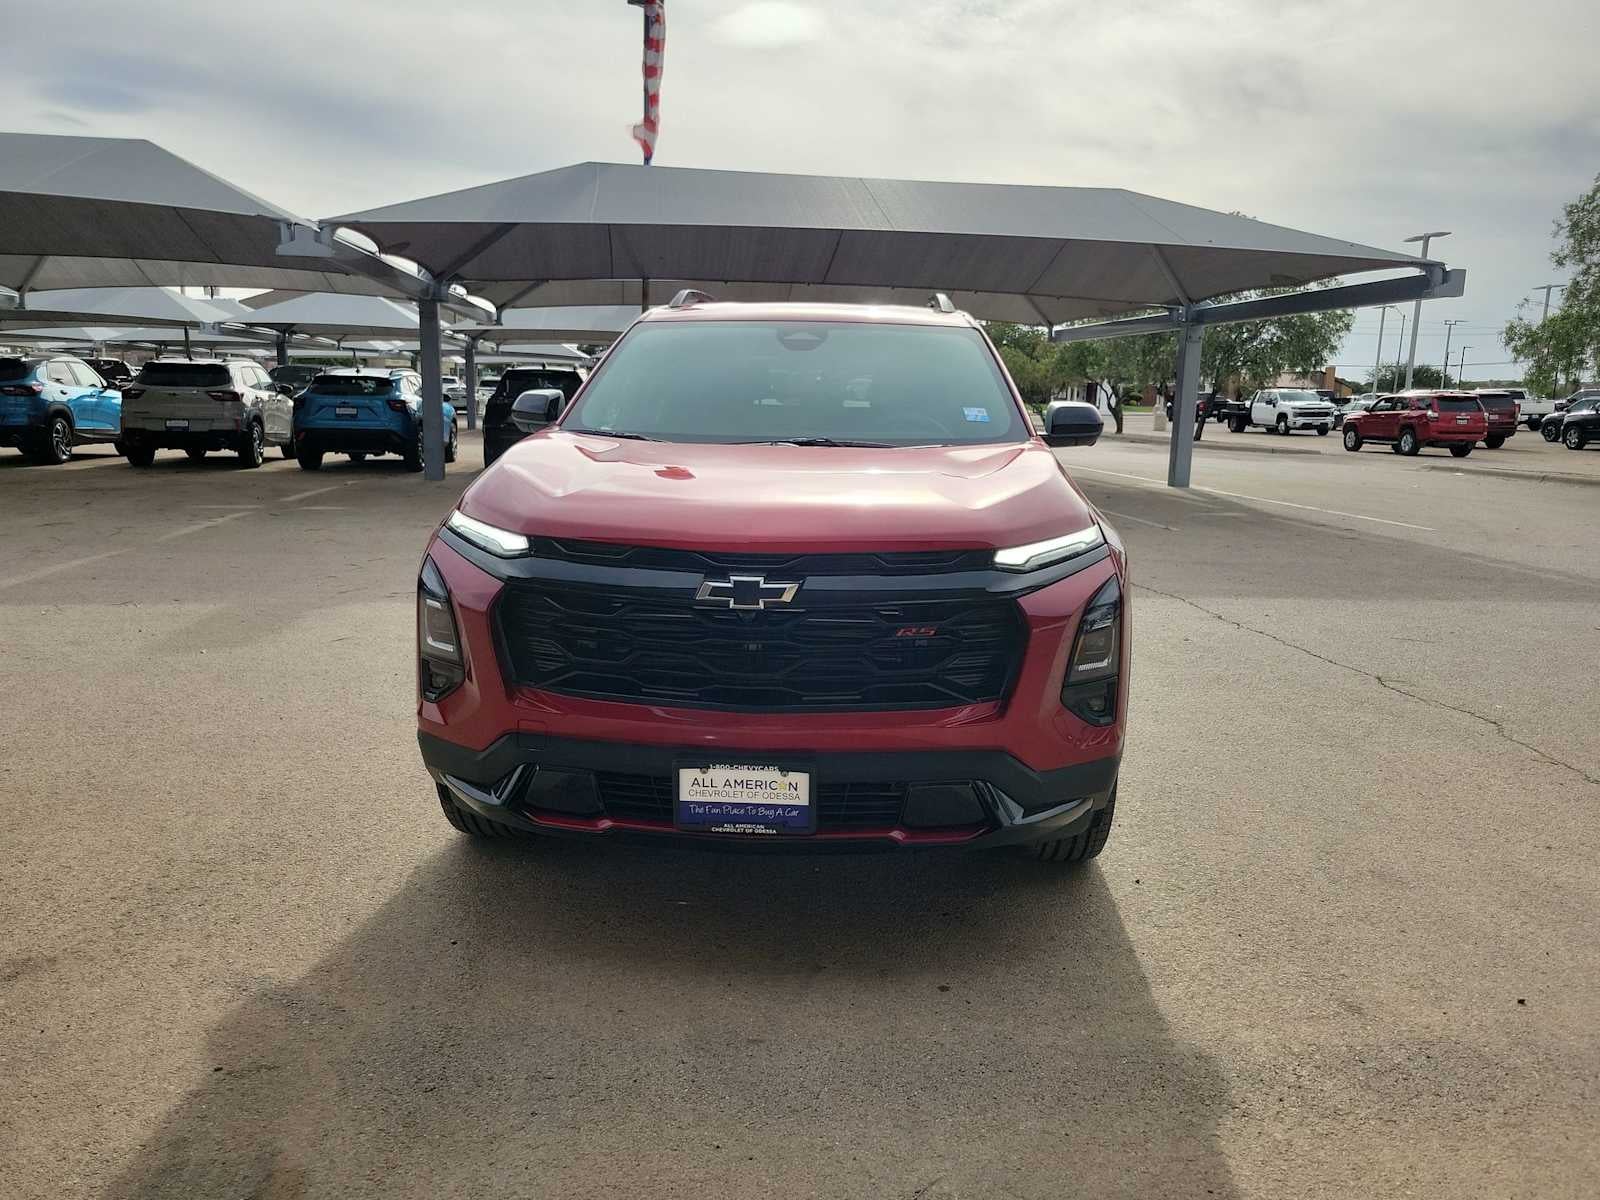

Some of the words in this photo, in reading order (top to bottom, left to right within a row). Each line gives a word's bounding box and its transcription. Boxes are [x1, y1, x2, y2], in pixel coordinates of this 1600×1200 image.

[896, 627, 936, 636] RS
[691, 777, 717, 788] ALL
[688, 789, 744, 799] CHEVROLET
[746, 790, 760, 799] OF
[762, 792, 801, 801] ODESSA
[689, 804, 704, 815] The
[723, 804, 745, 816] Place
[746, 805, 756, 816] To
[758, 805, 774, 819] Buy
[775, 806, 784, 817] A
[785, 807, 800, 817] Car
